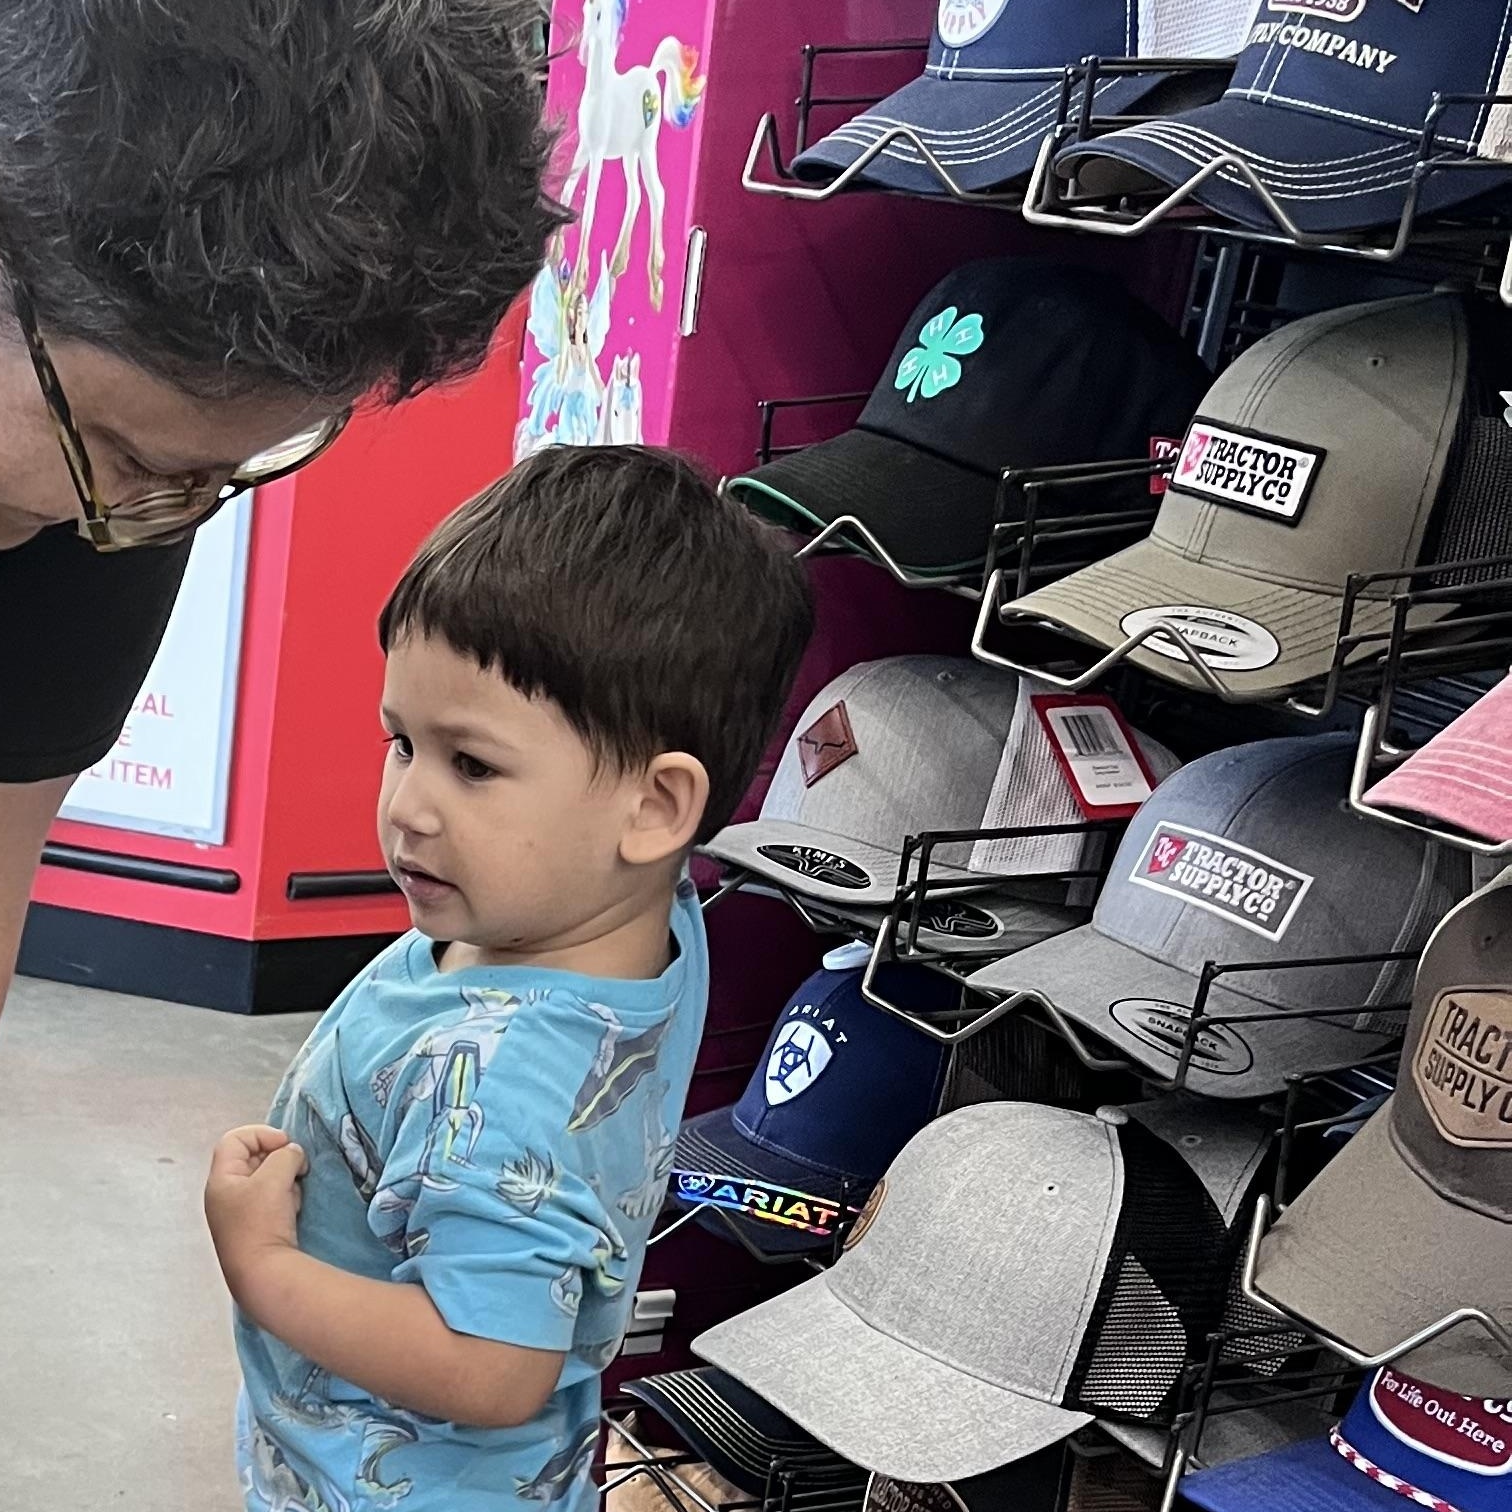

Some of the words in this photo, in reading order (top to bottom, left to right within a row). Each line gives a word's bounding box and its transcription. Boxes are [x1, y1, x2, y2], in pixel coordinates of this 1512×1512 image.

[1279, 24, 1398, 74] COMPANY
[1195, 460, 1264, 497] SUPPLY
[1205, 436, 1298, 480] TRACTOR
[1178, 627, 1239, 648] APBACK
[109, 759, 173, 790] ITEM
[1169, 861, 1250, 907] SUPPLY
[1182, 841, 1284, 900] TRACTOR
[789, 1004, 847, 1043] ARIAT
[1148, 1016, 1218, 1051] SNAPCK
[1424, 1048, 1501, 1113] SUPPLY
[712, 1184, 839, 1225] ARIAT
[1397, 1383, 1424, 1408] Life
[1424, 1399, 1456, 1427] Out
[1456, 1417, 1506, 1454] Here
